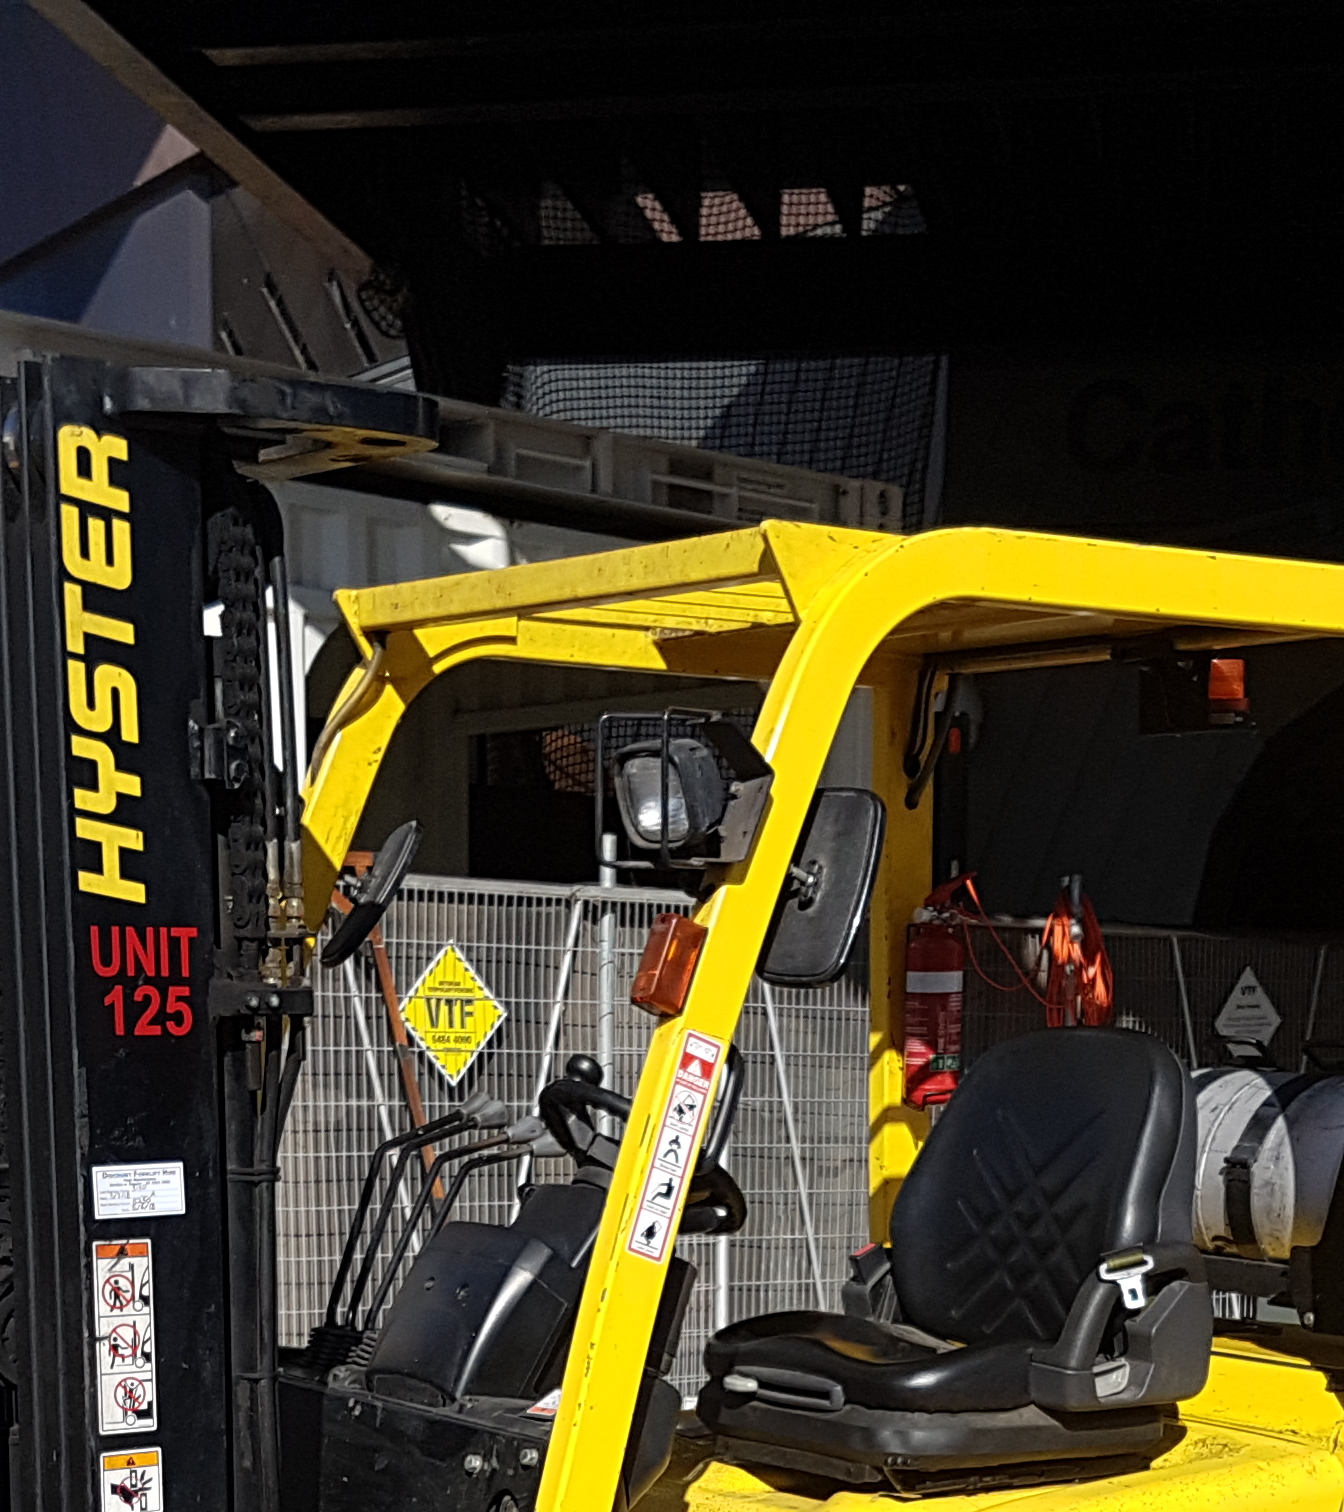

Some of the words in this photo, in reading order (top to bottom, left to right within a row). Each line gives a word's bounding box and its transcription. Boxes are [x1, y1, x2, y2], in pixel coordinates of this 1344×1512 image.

[58, 423, 147, 904] HYSTER
[90, 926, 198, 978] UNIT
[103, 985, 193, 1037] 125
[425, 997, 474, 1030] VTF
[677, 1069, 710, 1090] DANGER
